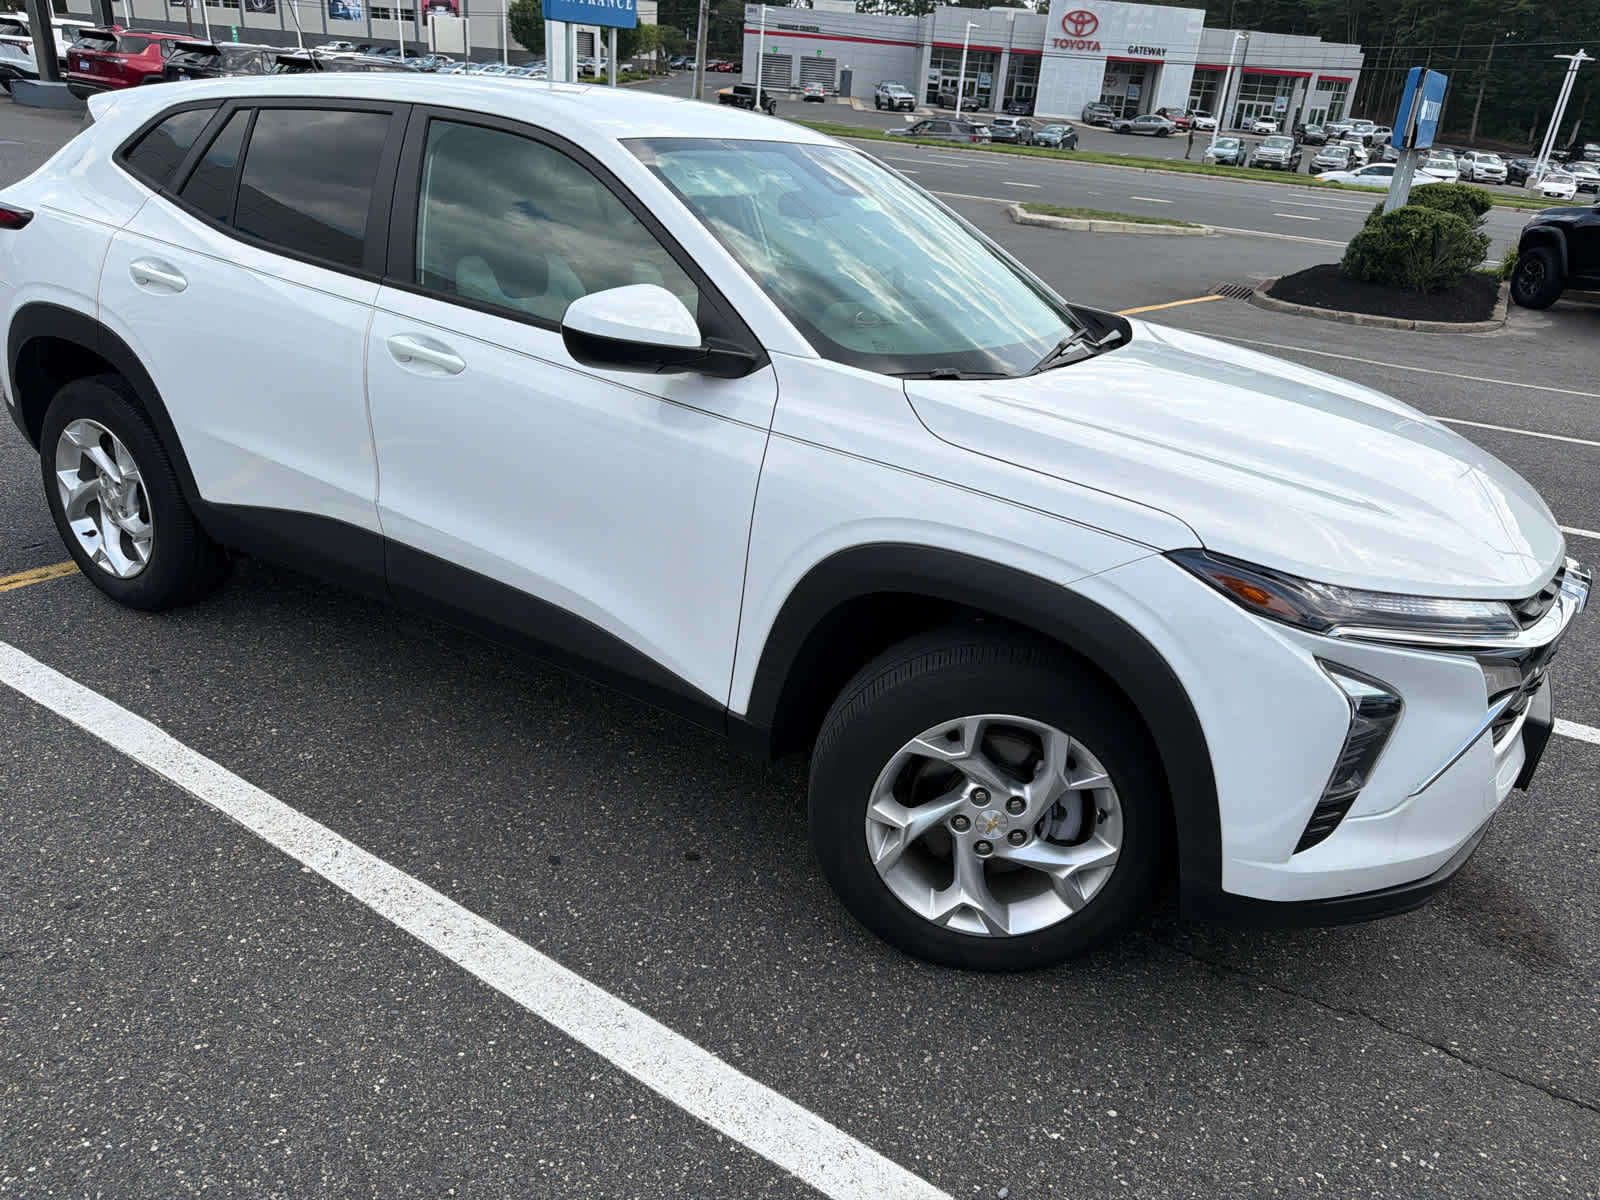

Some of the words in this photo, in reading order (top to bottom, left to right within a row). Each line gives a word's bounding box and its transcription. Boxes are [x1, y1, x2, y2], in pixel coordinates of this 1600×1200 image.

[559, 0, 633, 10] RANCE
[1053, 38, 1101, 52] TOYOTA
[1127, 45, 1167, 57] GATEWAY
